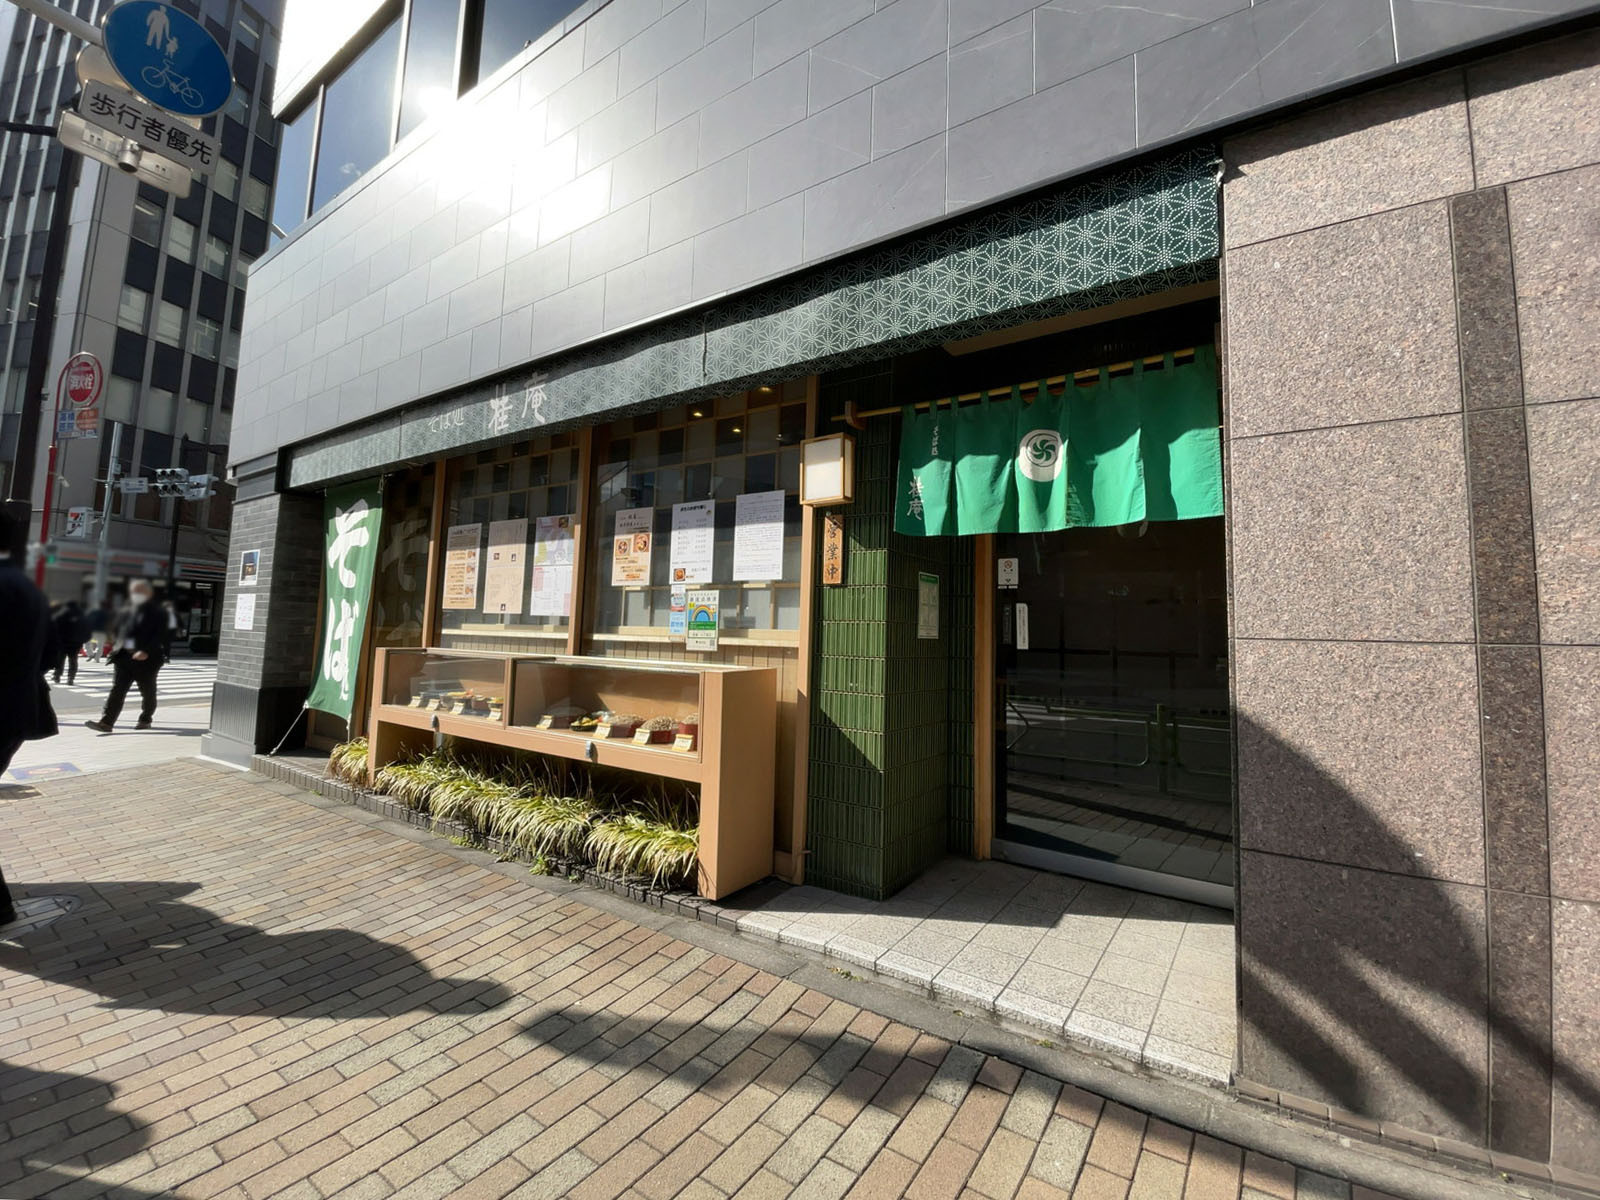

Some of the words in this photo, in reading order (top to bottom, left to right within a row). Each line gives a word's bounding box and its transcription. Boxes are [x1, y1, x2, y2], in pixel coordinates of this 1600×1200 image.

[89, 91, 214, 166] 歩行者優先
[826, 522, 840, 580] 営業中
[323, 498, 370, 701] そば
